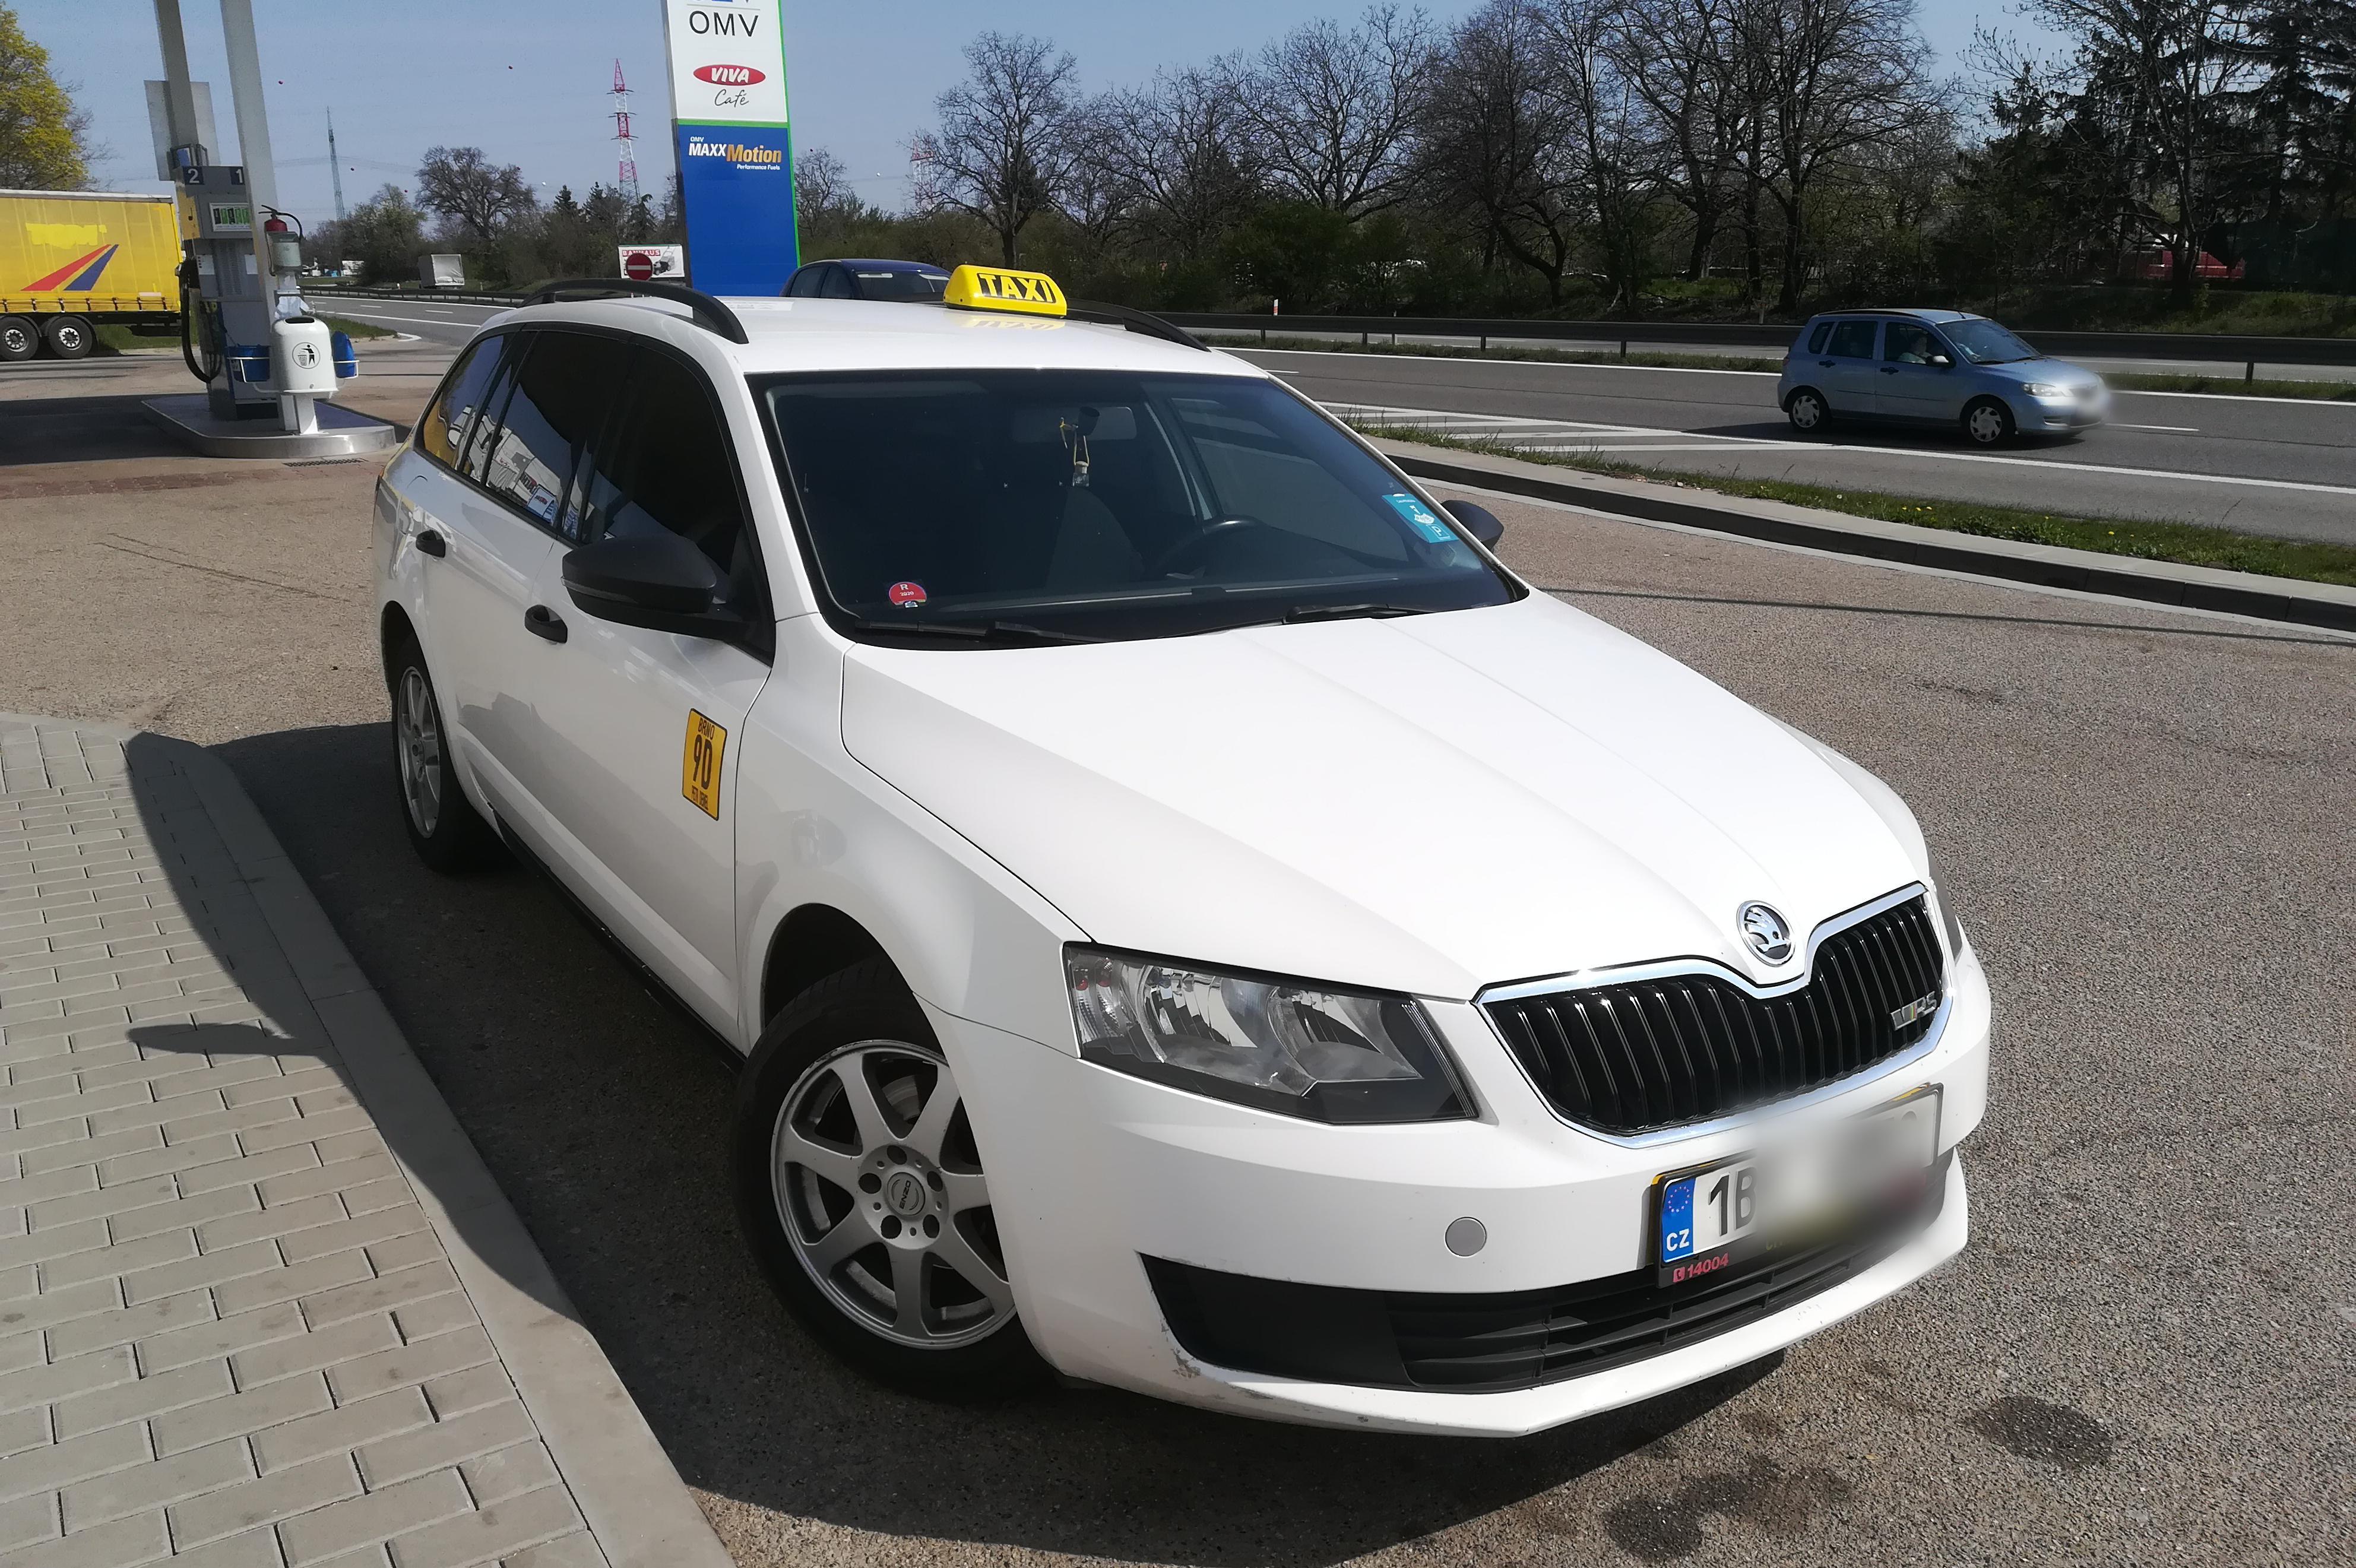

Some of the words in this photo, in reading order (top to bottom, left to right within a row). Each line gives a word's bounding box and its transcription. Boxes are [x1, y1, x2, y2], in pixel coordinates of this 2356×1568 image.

[689, 11, 758, 37] OMV
[711, 66, 749, 83] VIVA
[714, 88, 749, 107] Café
[188, 168, 200, 183] 2
[236, 169, 243, 183] 1
[979, 273, 1053, 303] TAXI
[698, 717, 715, 740] BRNO
[899, 1180, 912, 1209] ENZO
[1666, 1228, 1690, 1252] CZ
[1687, 1252, 1730, 1278] 14004
